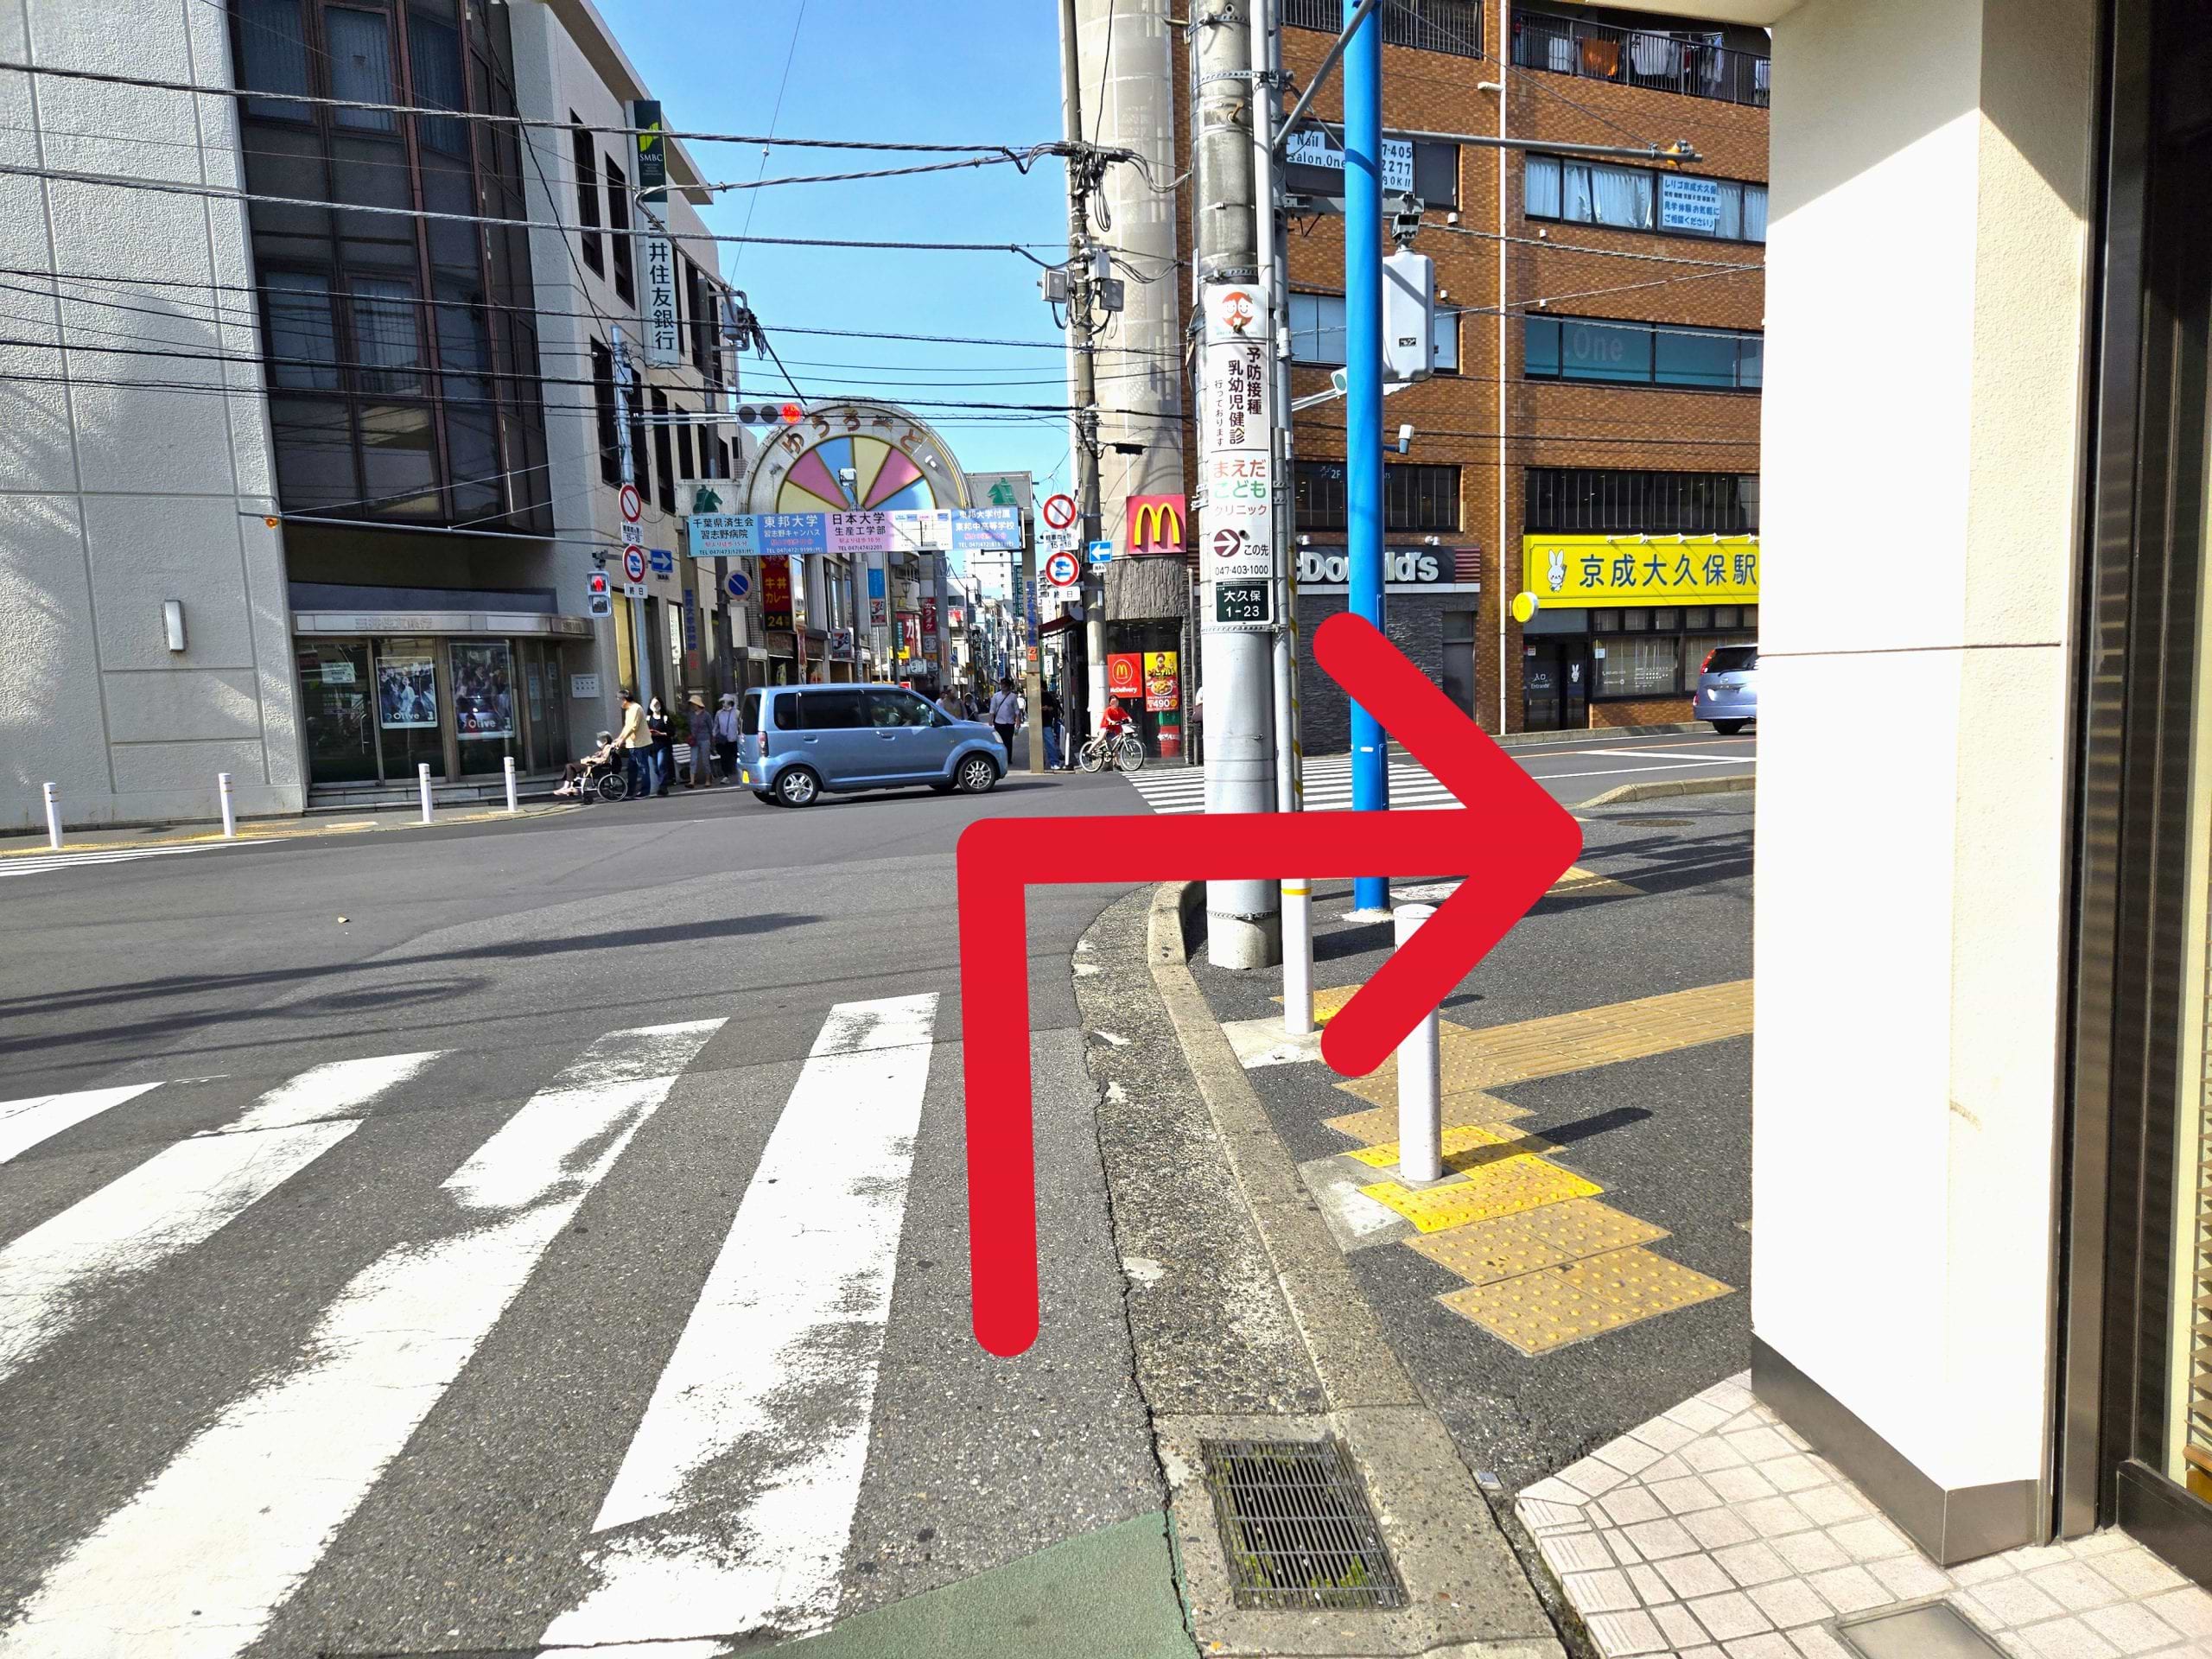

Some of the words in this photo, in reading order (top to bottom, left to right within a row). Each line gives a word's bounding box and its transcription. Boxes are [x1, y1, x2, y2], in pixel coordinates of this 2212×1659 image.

[1296, 134, 1319, 148] Nail
[639, 153, 664, 162] SMBC
[647, 219, 676, 351] 三井住友銀行
[1246, 346, 1262, 416] 予防接種
[1228, 359, 1245, 446] 乳幼児健診
[1214, 380, 1224, 447] 行っております
[1213, 459, 1267, 479] まえだ
[1213, 480, 1267, 499] こども
[1214, 504, 1268, 517] クリニック
[693, 517, 754, 529] 千葉県済生会
[763, 514, 818, 528] 東邦大学
[832, 512, 886, 525] 日本大学
[700, 529, 749, 540] 習志野病院
[835, 525, 887, 537] 生産工学部
[1243, 543, 1269, 556] この先
[1579, 553, 1758, 588] 京成大久保駅
[766, 592, 790, 604] カレー
[1224, 590, 1262, 602] 大久保
[1225, 605, 1260, 618] 1-23
[393, 712, 420, 721] Olive
[468, 719, 497, 729] Olive
